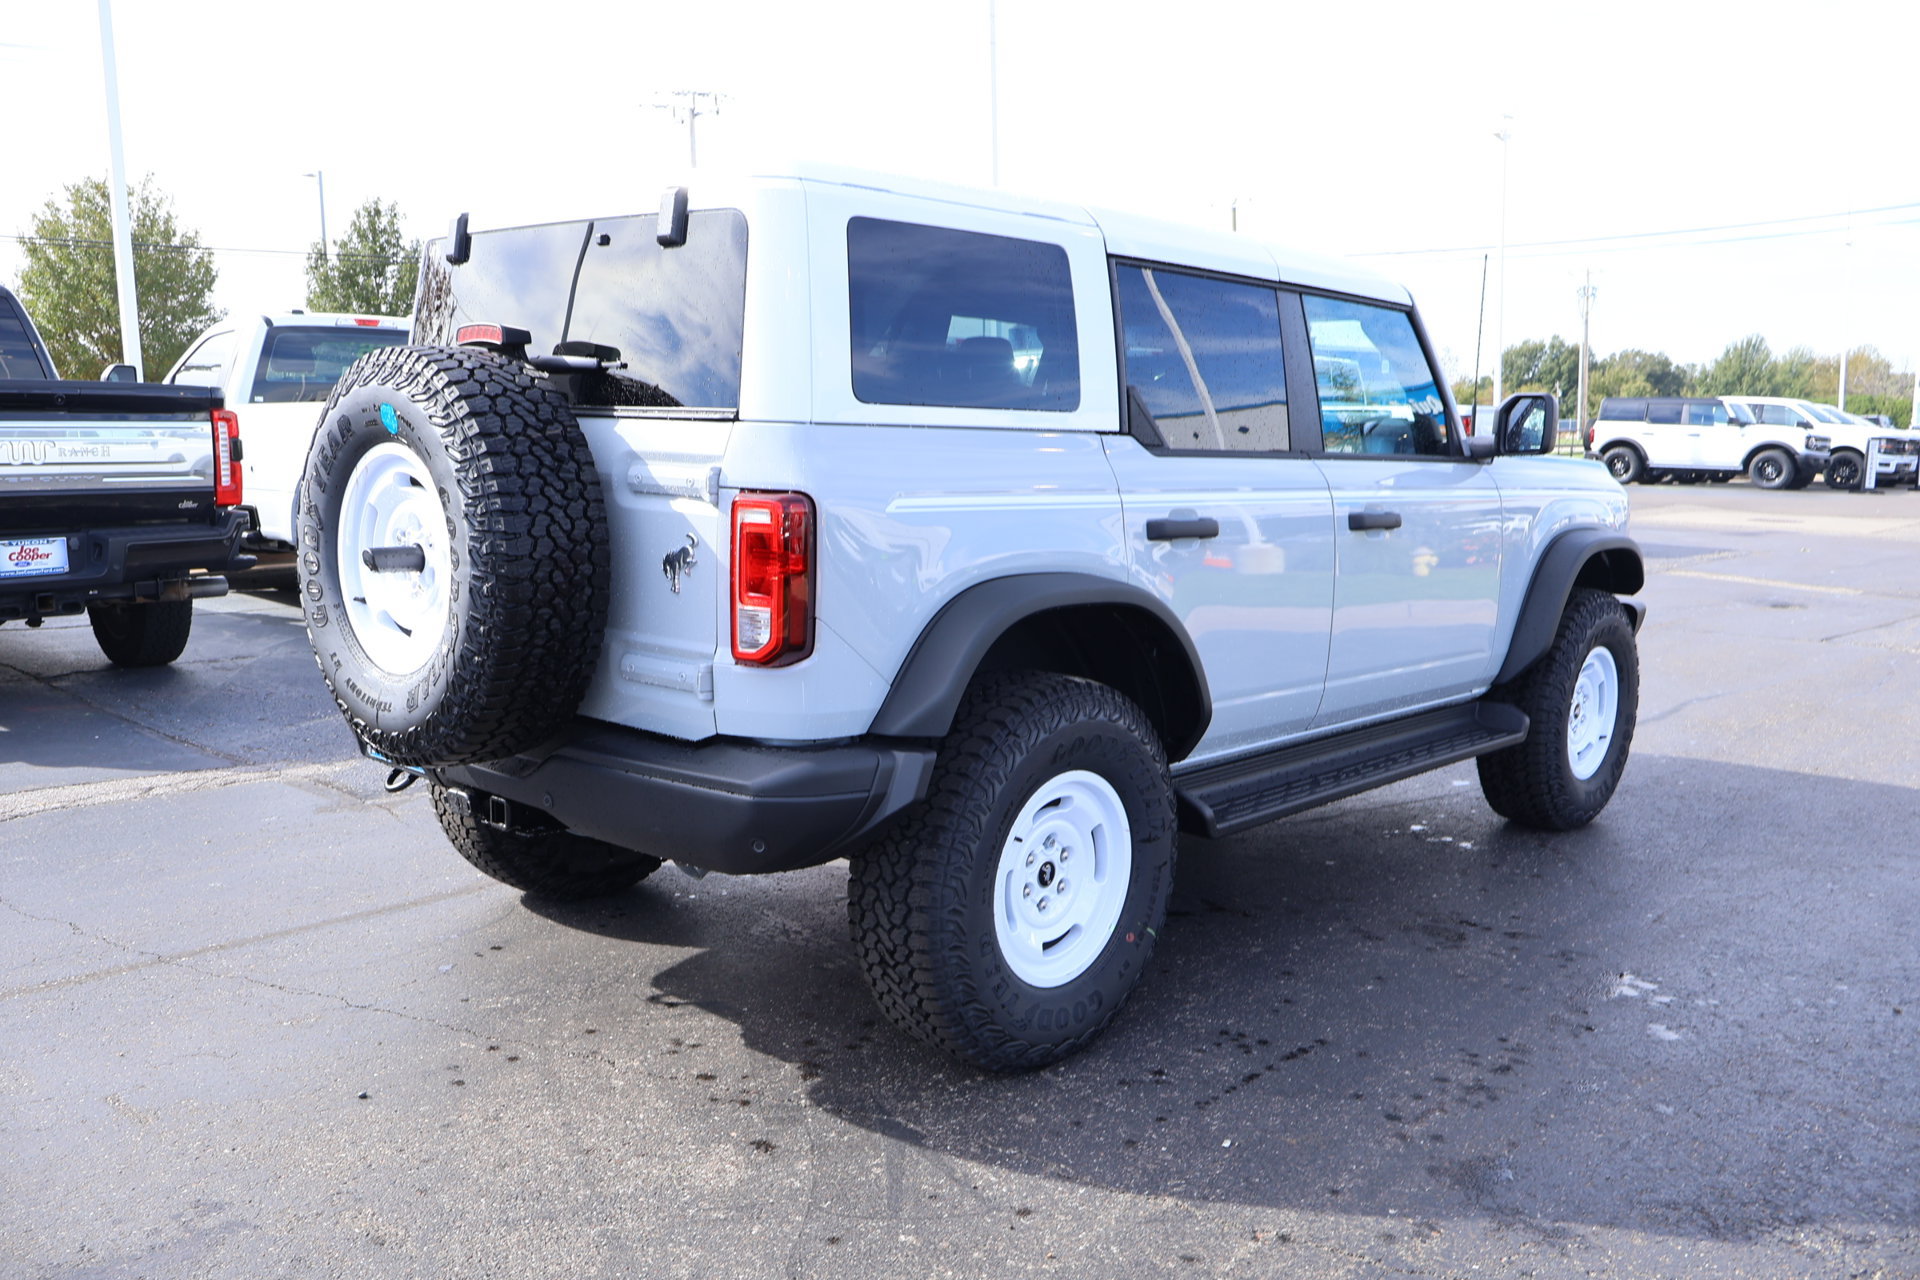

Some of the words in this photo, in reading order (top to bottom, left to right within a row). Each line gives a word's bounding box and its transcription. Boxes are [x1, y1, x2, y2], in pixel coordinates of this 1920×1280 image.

[57, 444, 111, 458] RANCH
[17, 545, 40, 555] Joe
[8, 552, 53, 562] Cooper
[344, 677, 393, 713] TERRITORY
